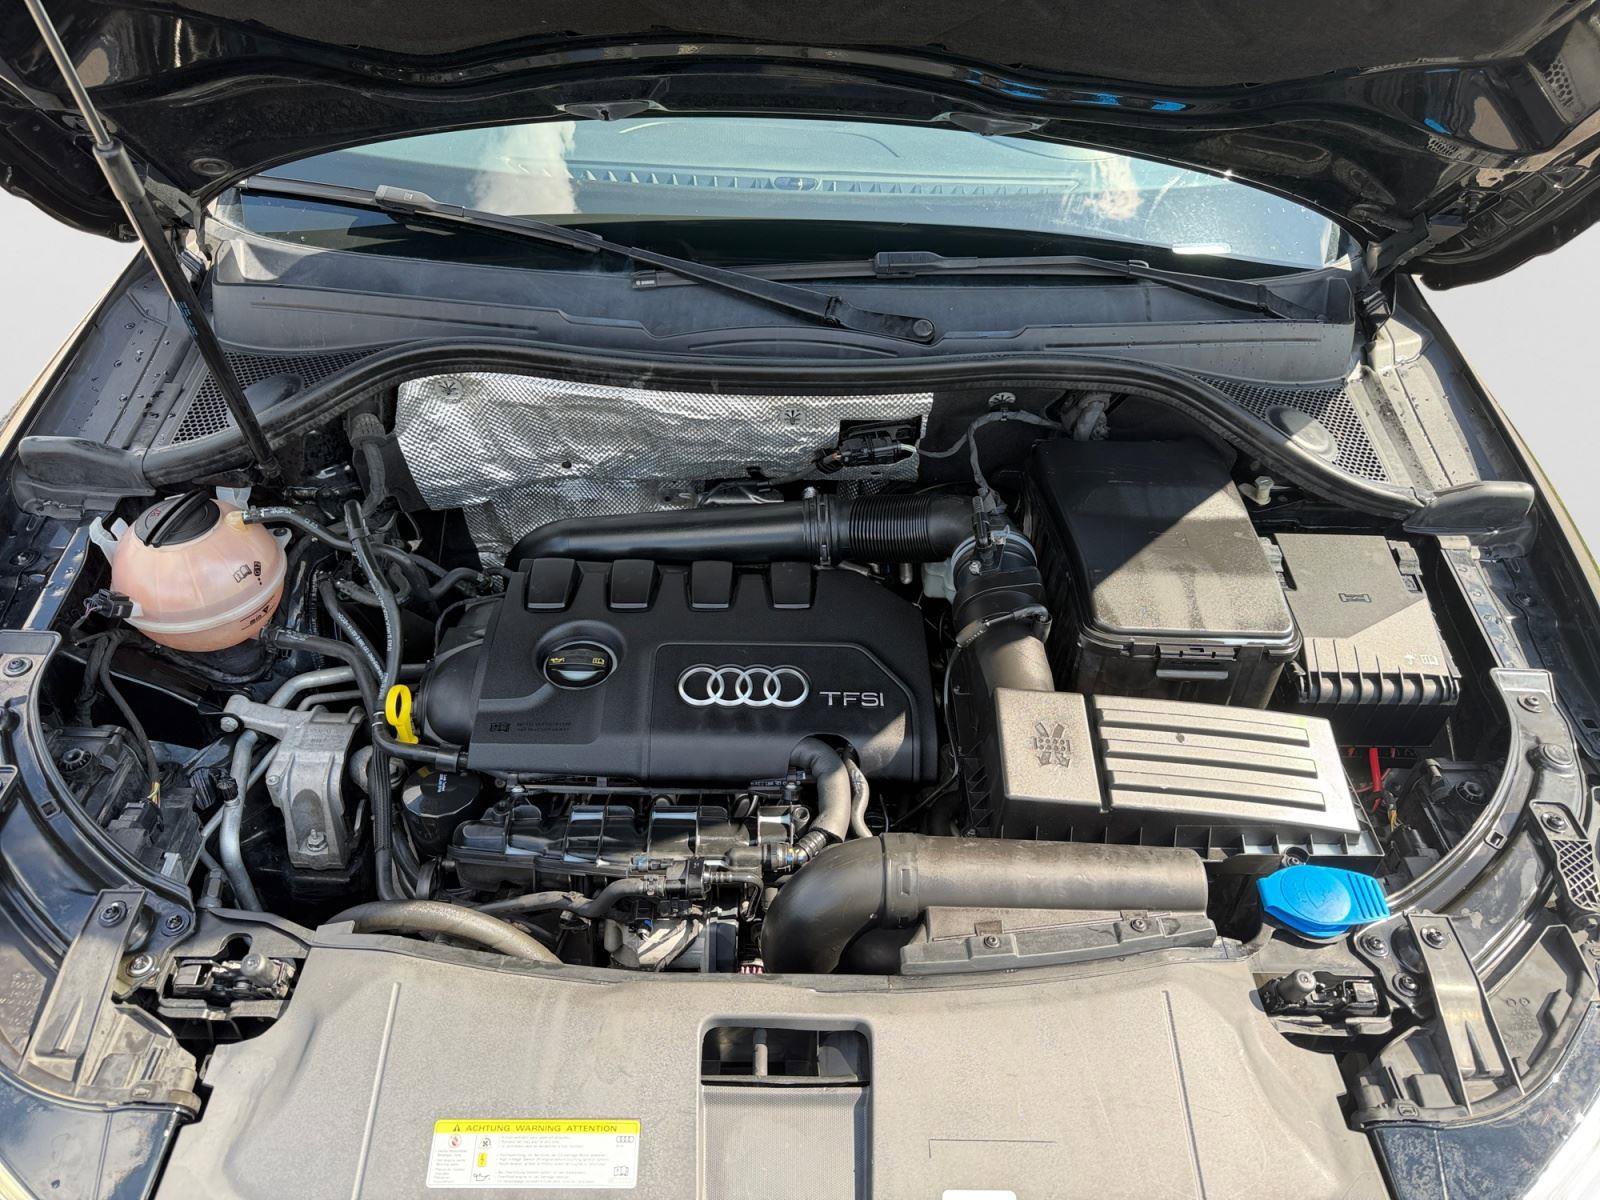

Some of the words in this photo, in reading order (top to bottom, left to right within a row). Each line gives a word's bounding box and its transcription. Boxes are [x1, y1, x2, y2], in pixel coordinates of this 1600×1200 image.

[819, 691, 885, 707] TFSI
[465, 1124, 510, 1132] ACHTUNG
[515, 1124, 561, 1132] WARNING
